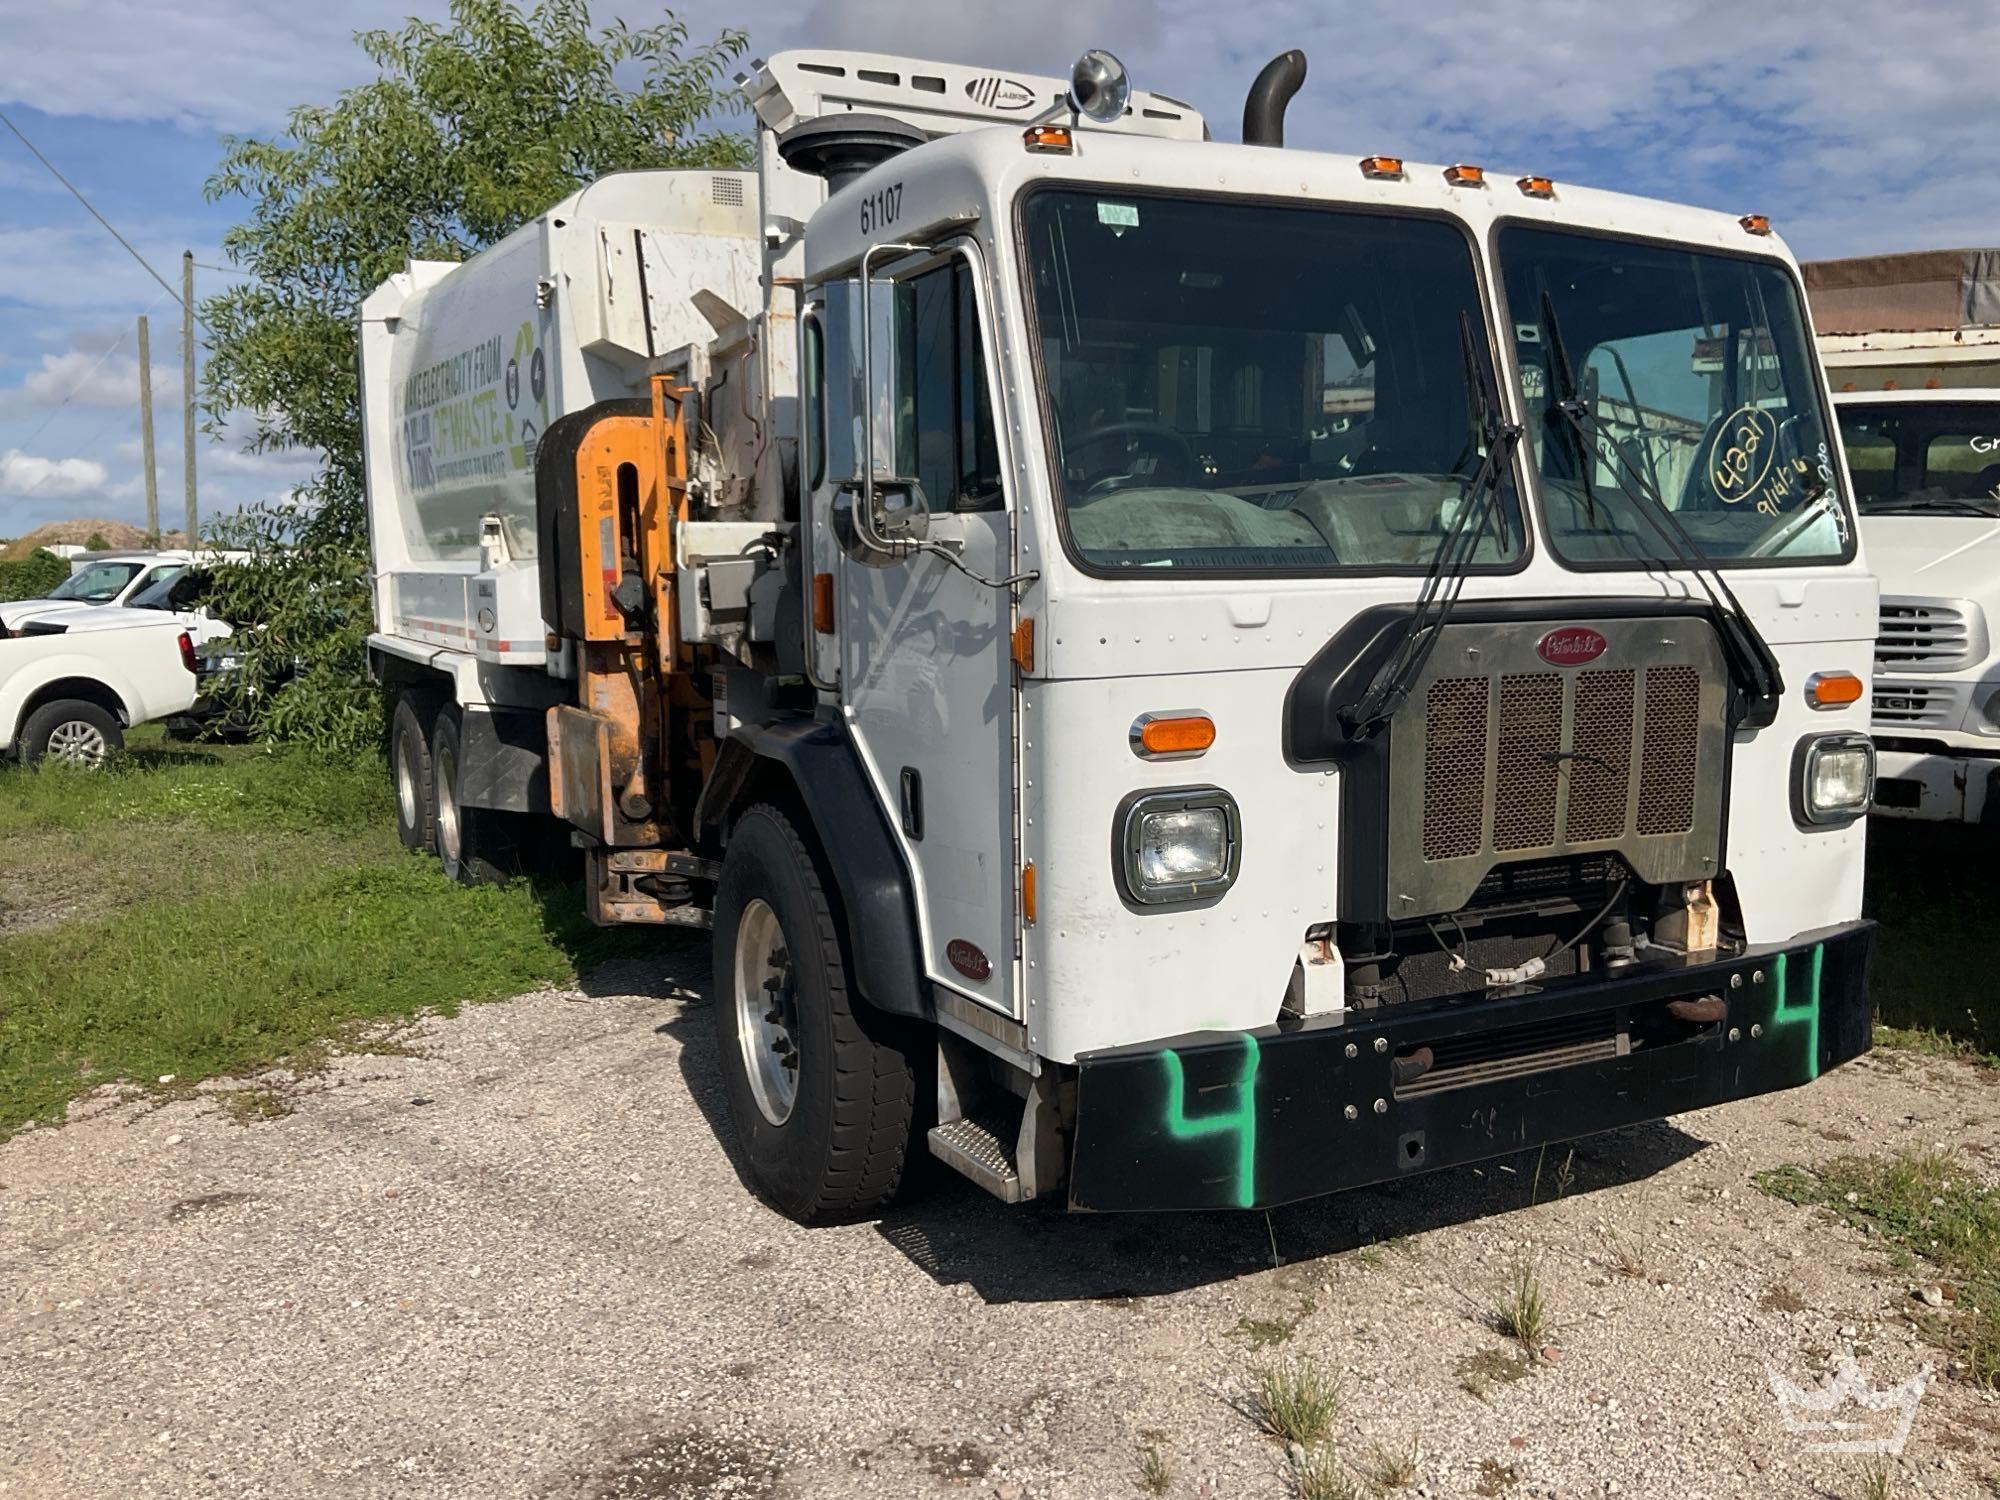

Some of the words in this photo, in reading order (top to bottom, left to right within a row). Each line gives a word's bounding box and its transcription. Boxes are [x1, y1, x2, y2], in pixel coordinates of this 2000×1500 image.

[859, 182, 904, 236] 61107
[474, 335, 502, 391] FROM
[1716, 415, 1765, 490] 4221
[1546, 635, 1602, 657] Peterbilt
[1775, 943, 1824, 1081] 4
[1162, 1031, 1261, 1210] 4
